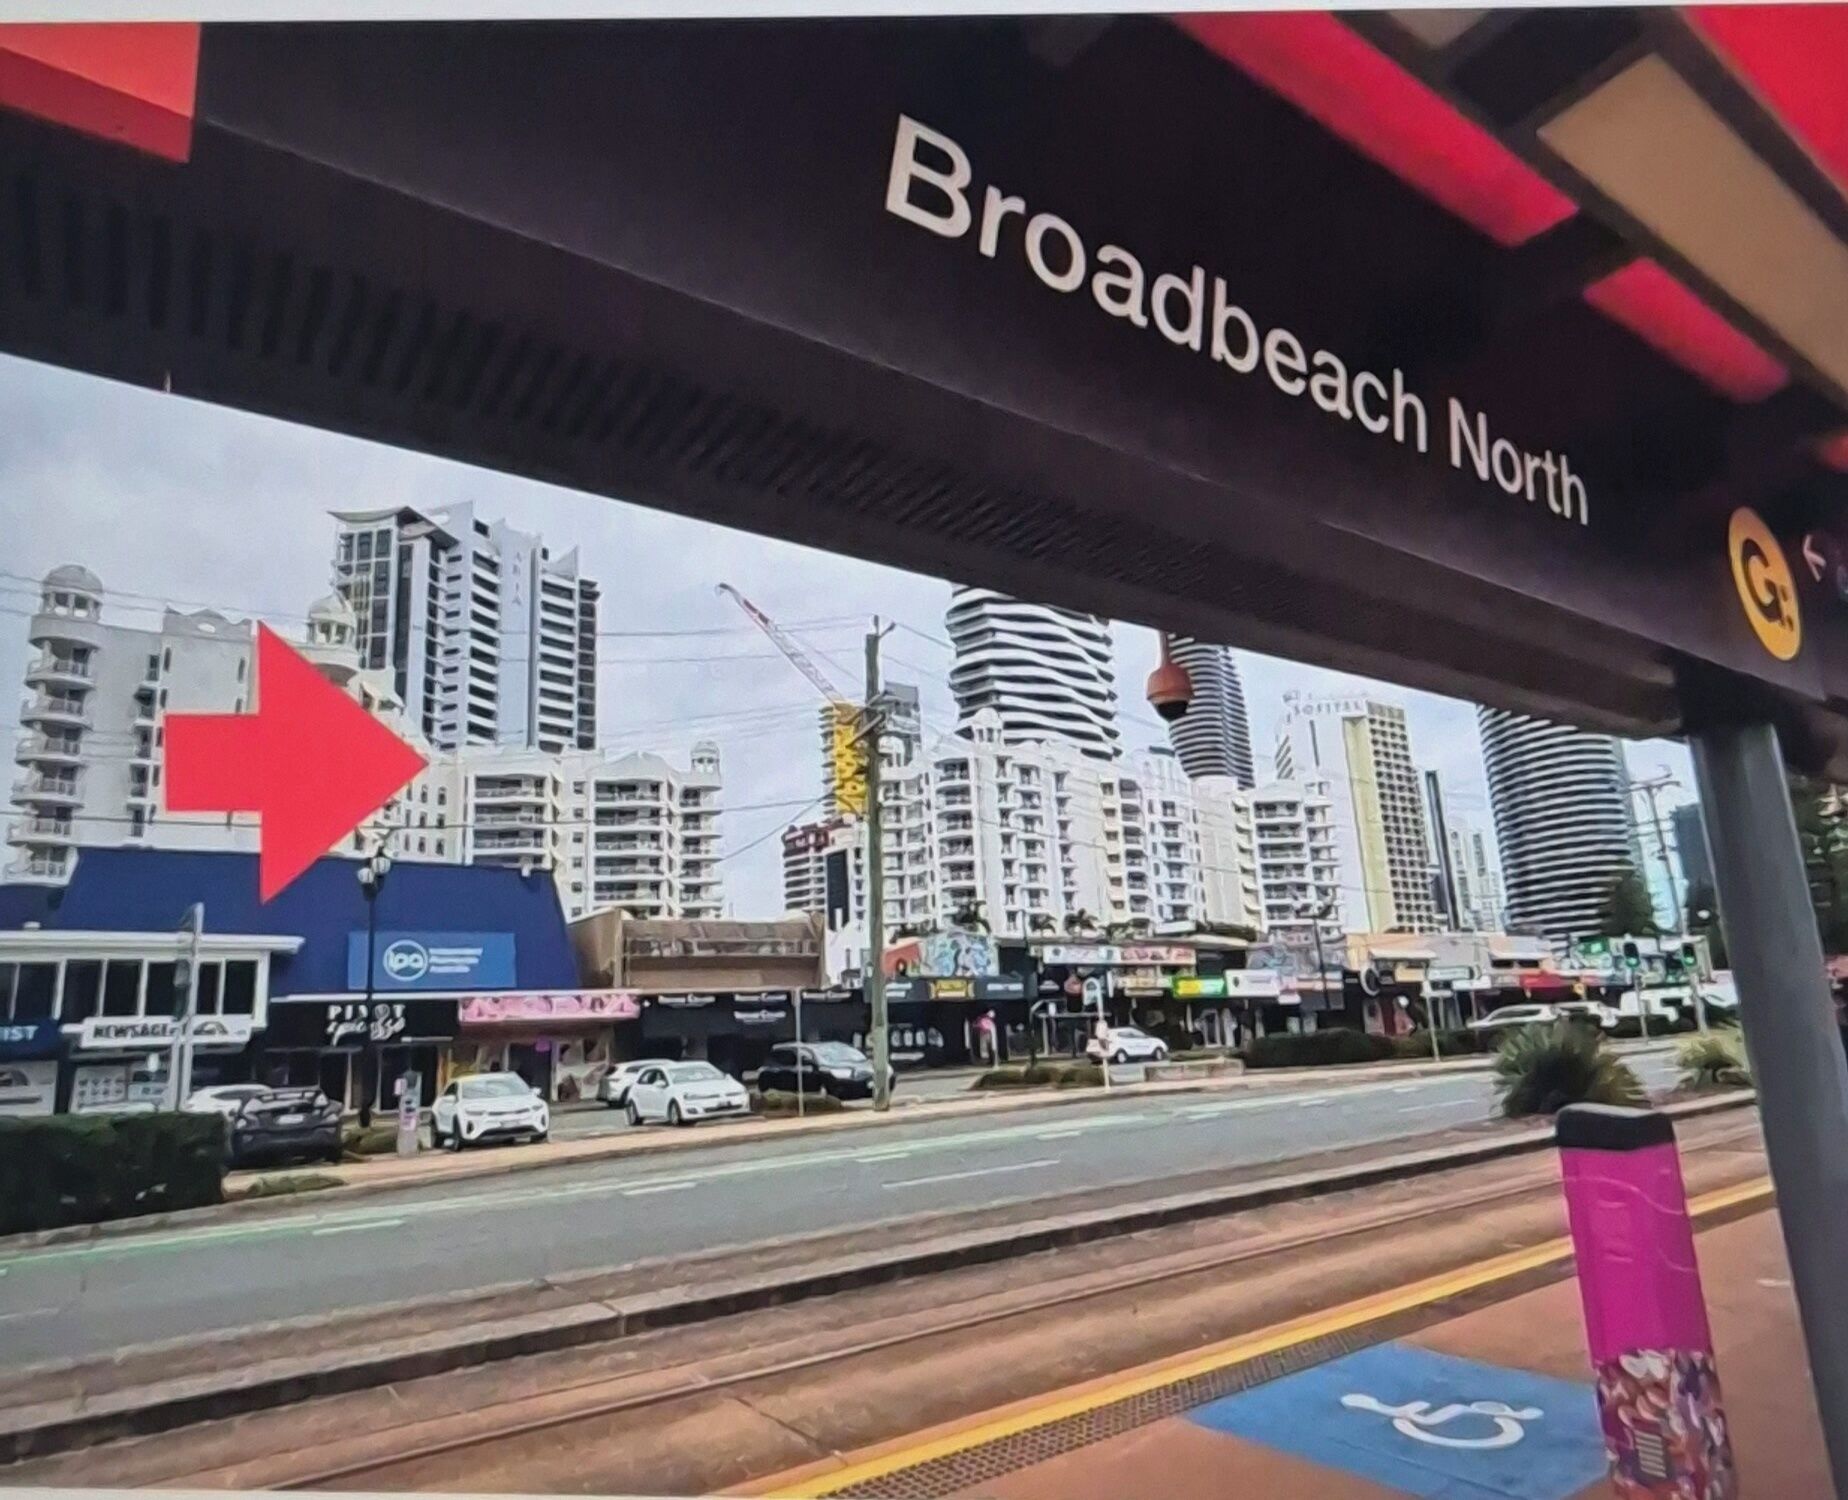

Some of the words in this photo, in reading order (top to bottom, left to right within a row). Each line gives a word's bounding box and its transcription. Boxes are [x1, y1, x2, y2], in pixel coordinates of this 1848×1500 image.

[885, 112, 1428, 453] Broadbeach
[1448, 397, 1590, 525] North
[0, 1025, 39, 1041] IST
